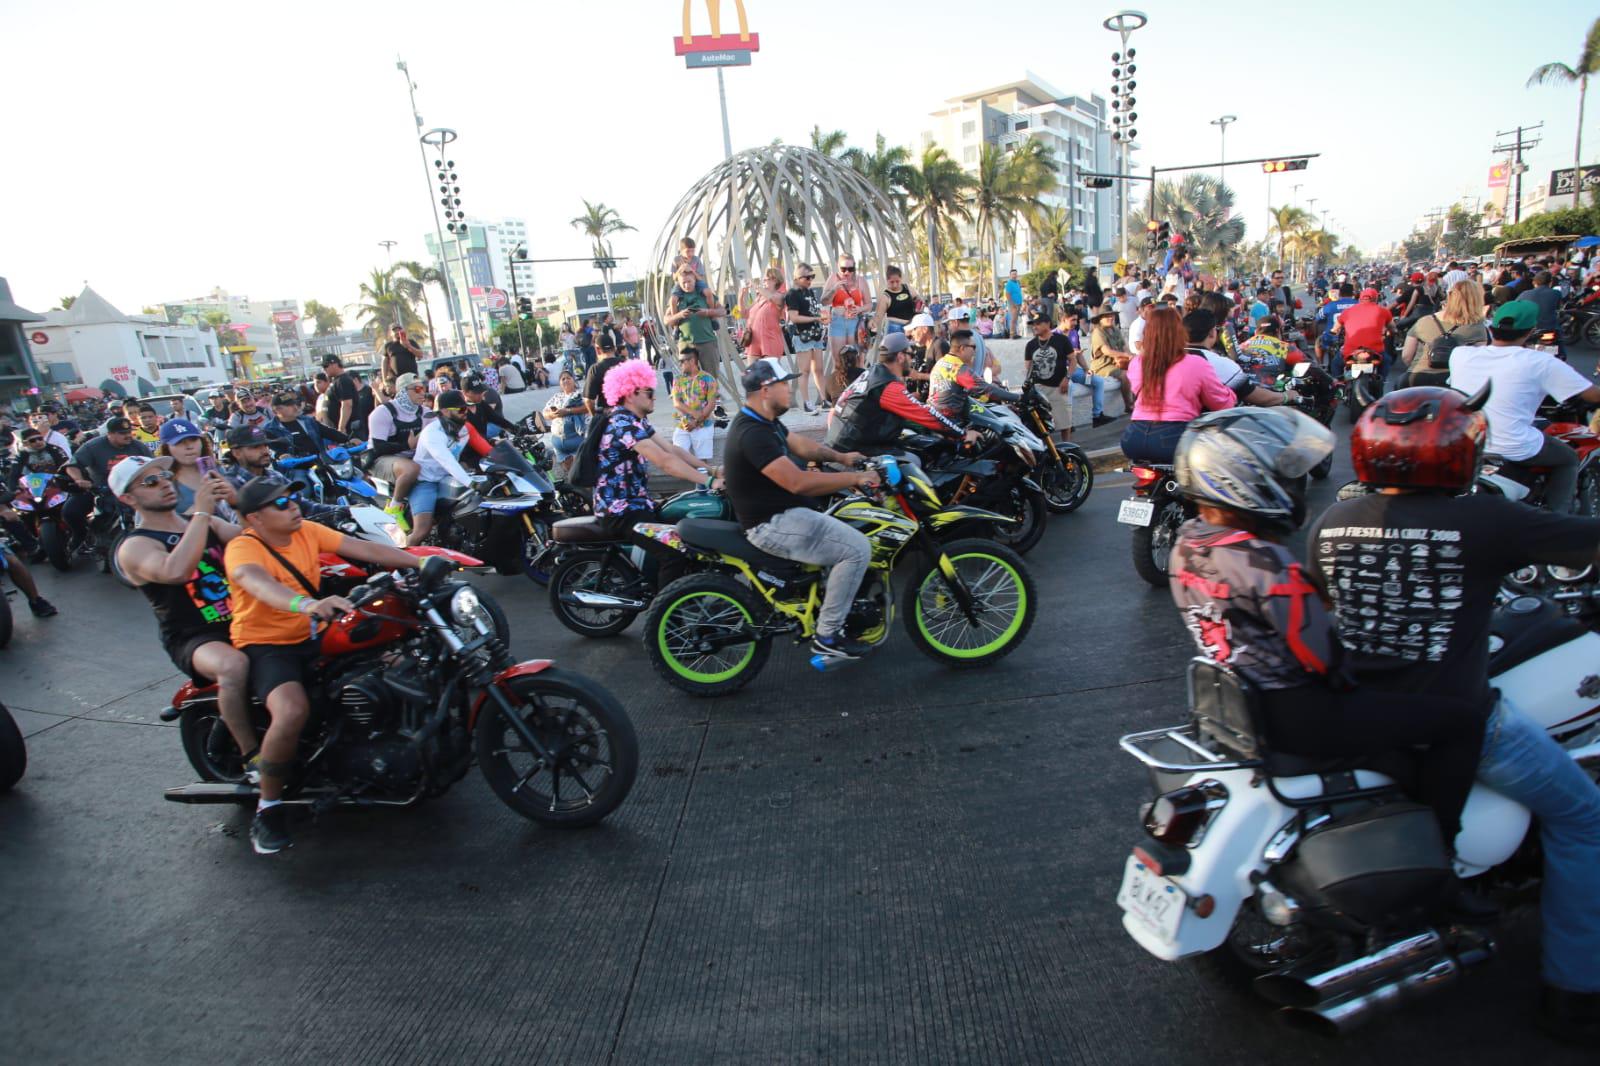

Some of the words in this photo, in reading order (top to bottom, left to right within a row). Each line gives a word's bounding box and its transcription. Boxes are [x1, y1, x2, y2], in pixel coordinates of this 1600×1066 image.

[702, 53, 736, 62] AutoMac
[1557, 175, 1600, 190] Digo
[1345, 526, 1383, 538] FIESTA
[1384, 528, 1399, 539] LA
